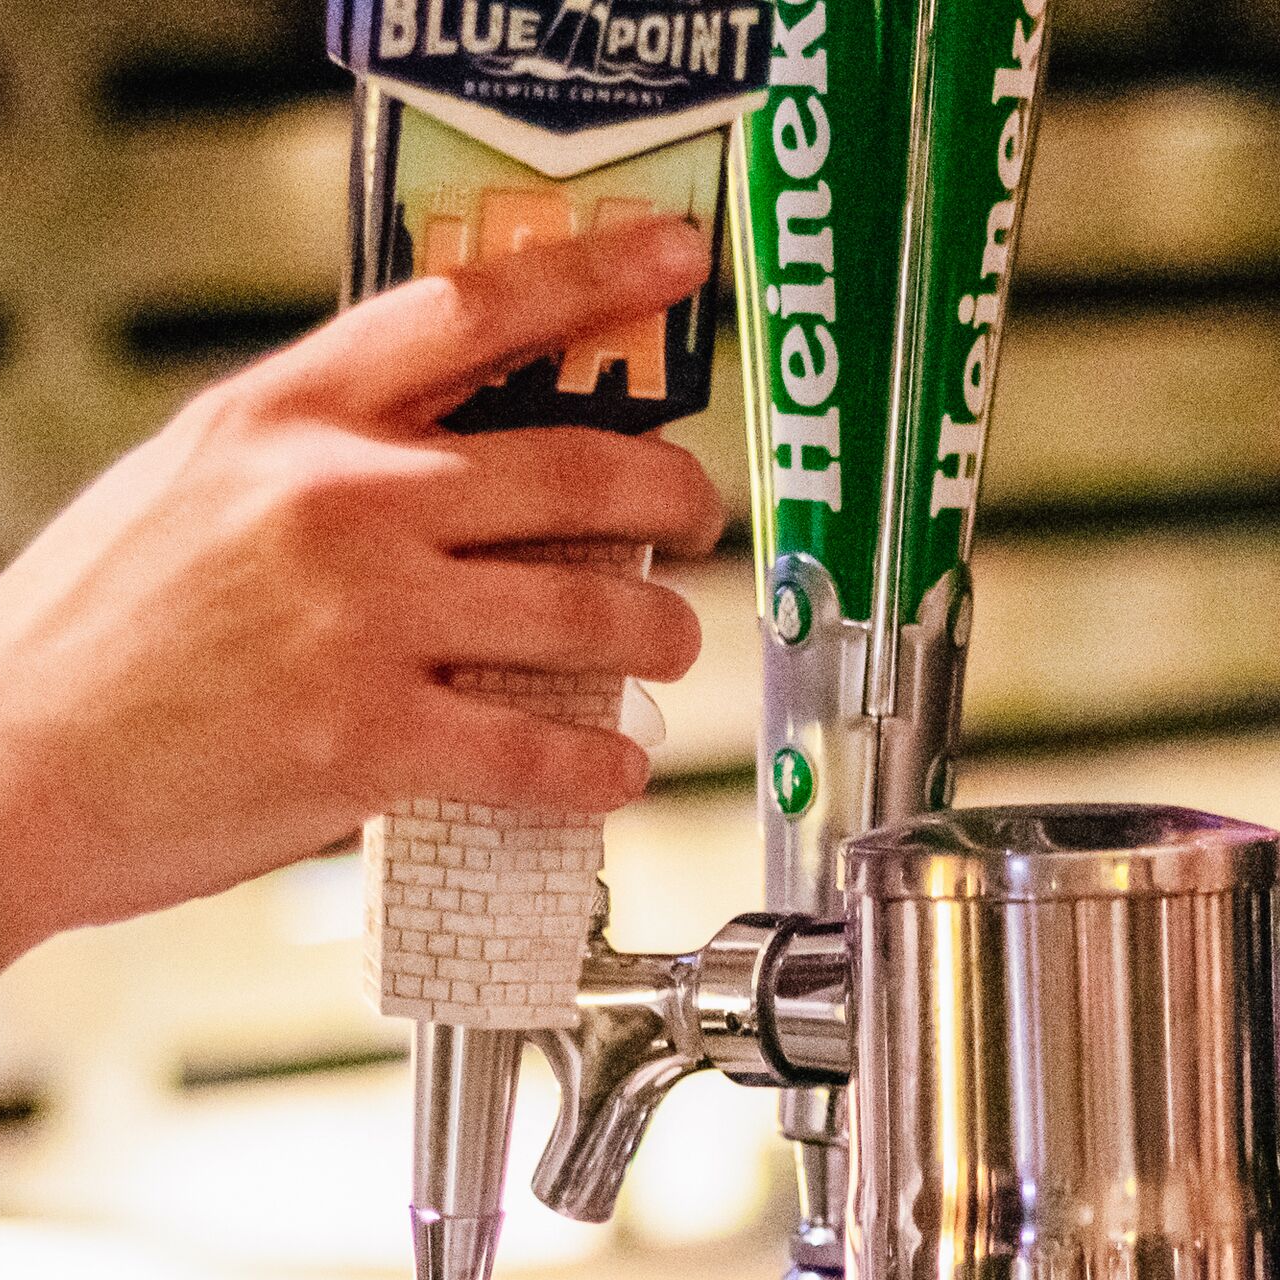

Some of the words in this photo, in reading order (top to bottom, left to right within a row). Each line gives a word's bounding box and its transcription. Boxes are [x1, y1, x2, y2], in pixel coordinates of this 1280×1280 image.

[379, 0, 541, 58] BLUE
[606, 8, 759, 81] POINT
[767, 0, 842, 514] Heinek
